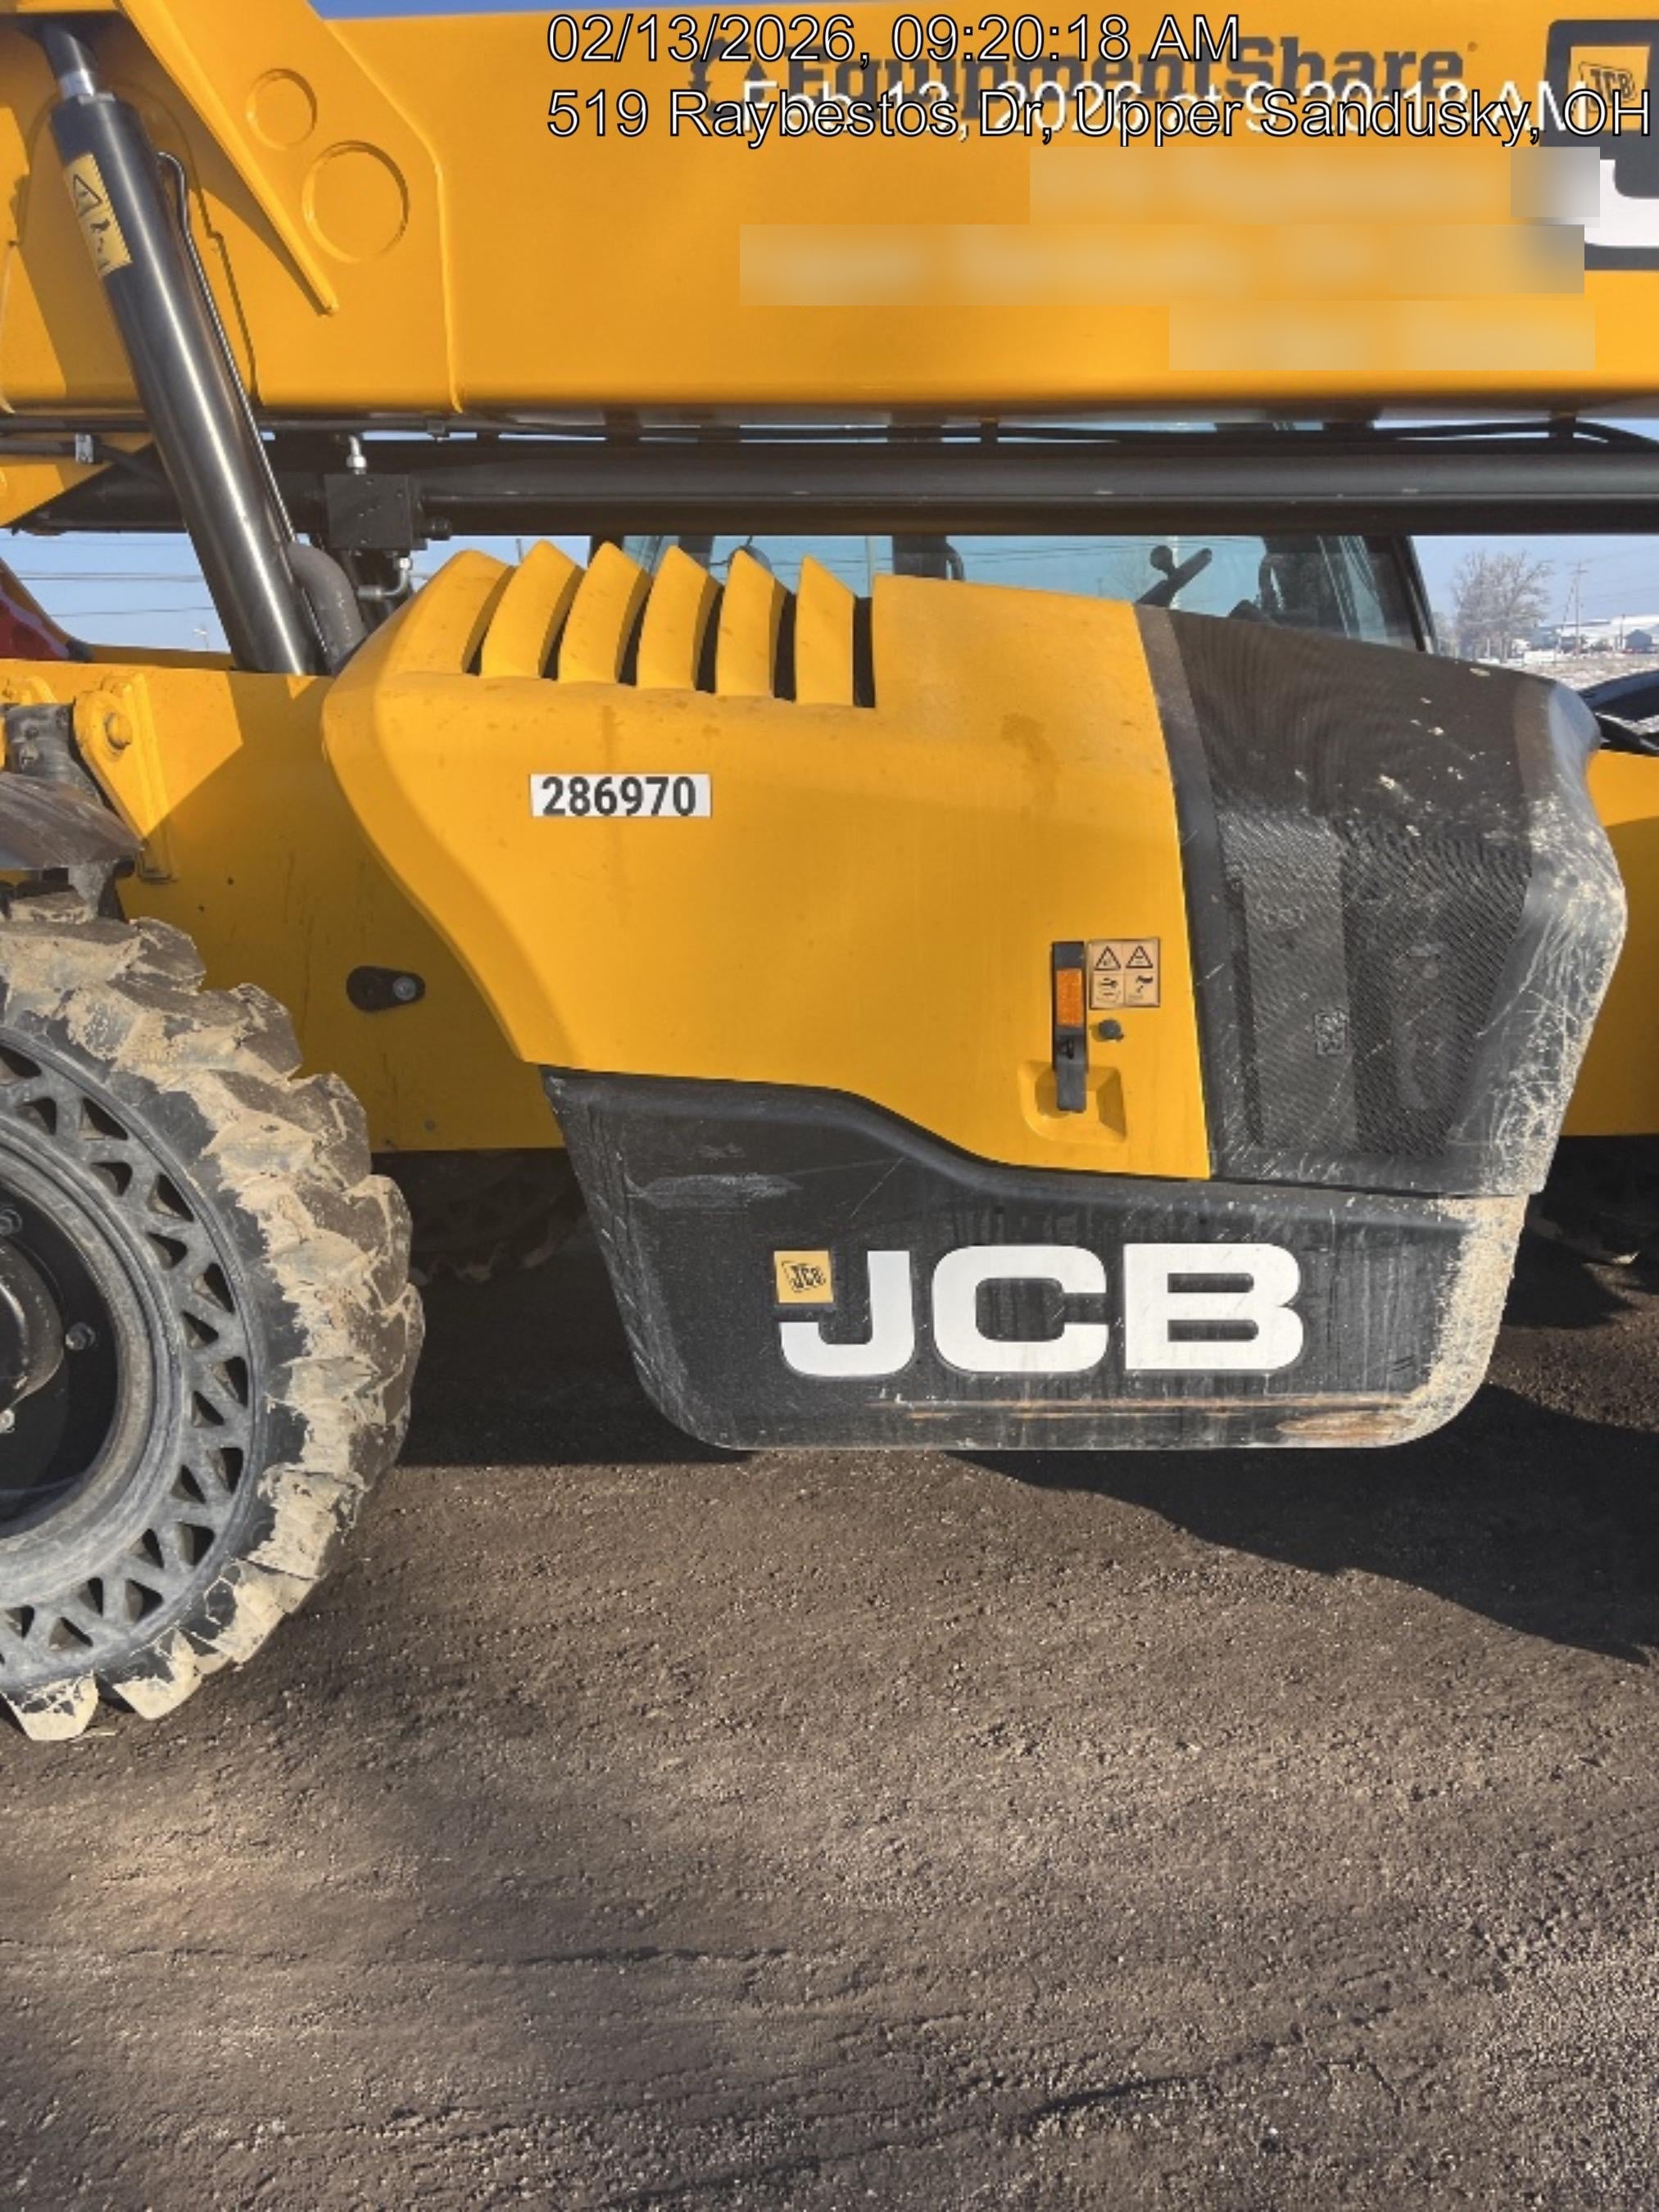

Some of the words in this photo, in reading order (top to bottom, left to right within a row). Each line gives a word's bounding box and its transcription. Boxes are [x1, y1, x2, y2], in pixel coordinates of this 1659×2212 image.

[542, 776, 696, 816] 286970
[791, 1264, 826, 1288] JCB
[779, 1243, 1303, 1376] JCB
